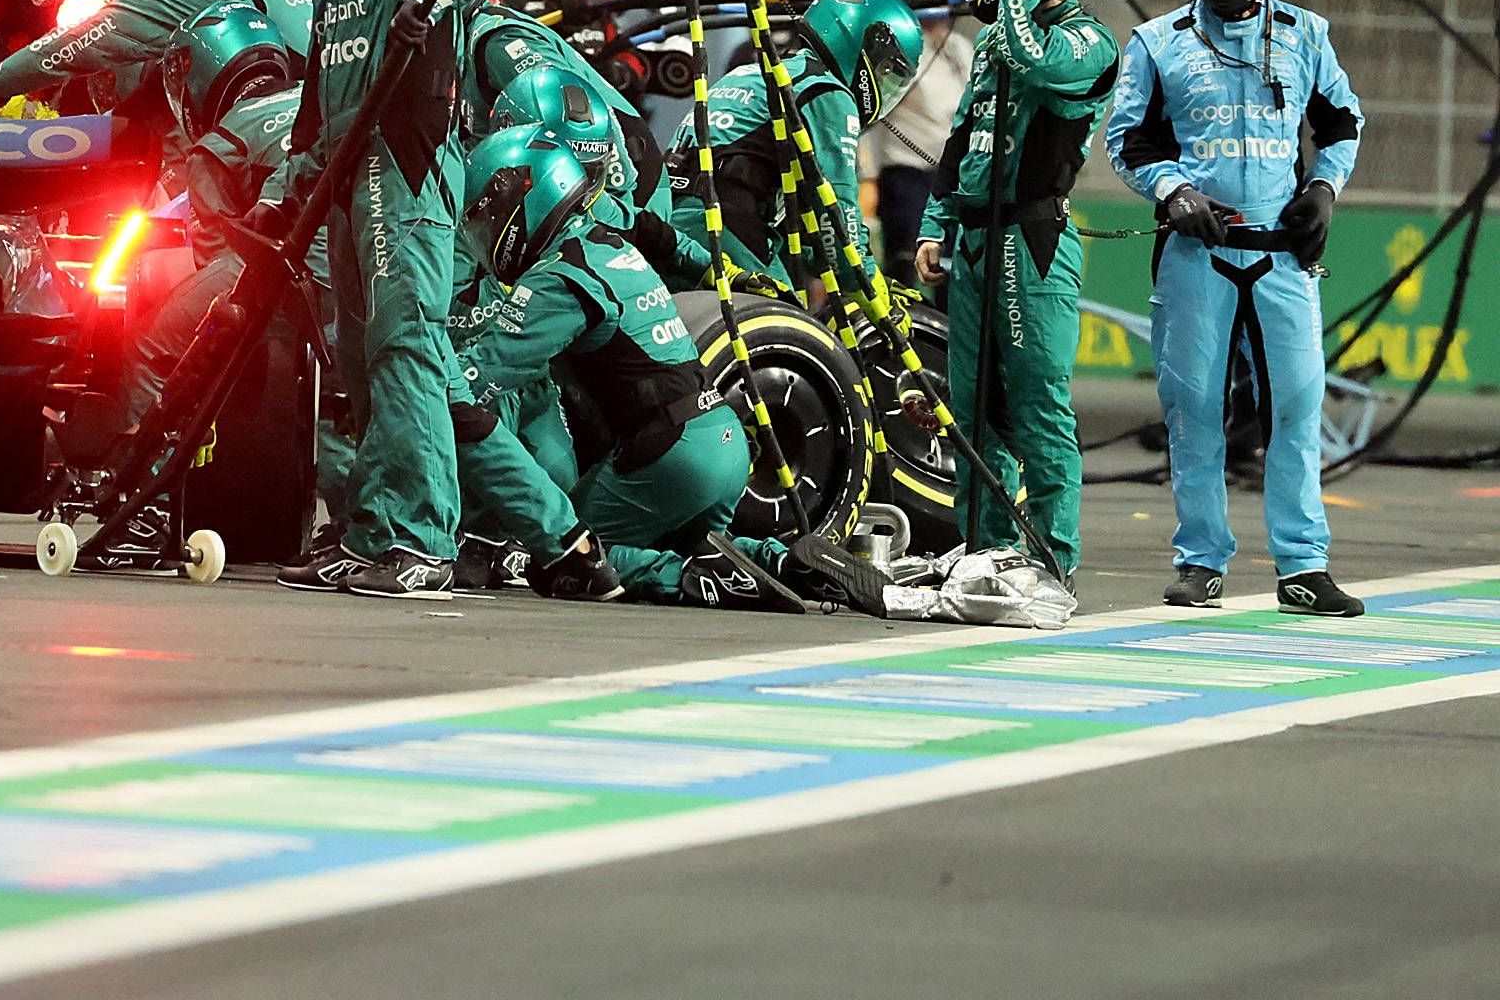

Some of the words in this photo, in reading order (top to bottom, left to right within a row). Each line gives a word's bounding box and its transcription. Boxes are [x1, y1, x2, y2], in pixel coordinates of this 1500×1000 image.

[40, 17, 117, 71] cognizant
[514, 52, 544, 75] EPOS
[858, 69, 873, 115] cognizant
[1189, 103, 1294, 127] cognizant
[581, 142, 610, 154] MARTIN
[1192, 135, 1292, 160] aramco
[367, 154, 381, 218] MARTIN
[373, 222, 389, 278] ASTON
[1003, 234, 1016, 293] MARTIN
[1007, 298, 1024, 349] ASTON
[853, 384, 868, 407] P
[842, 417, 873, 538] ZERO
